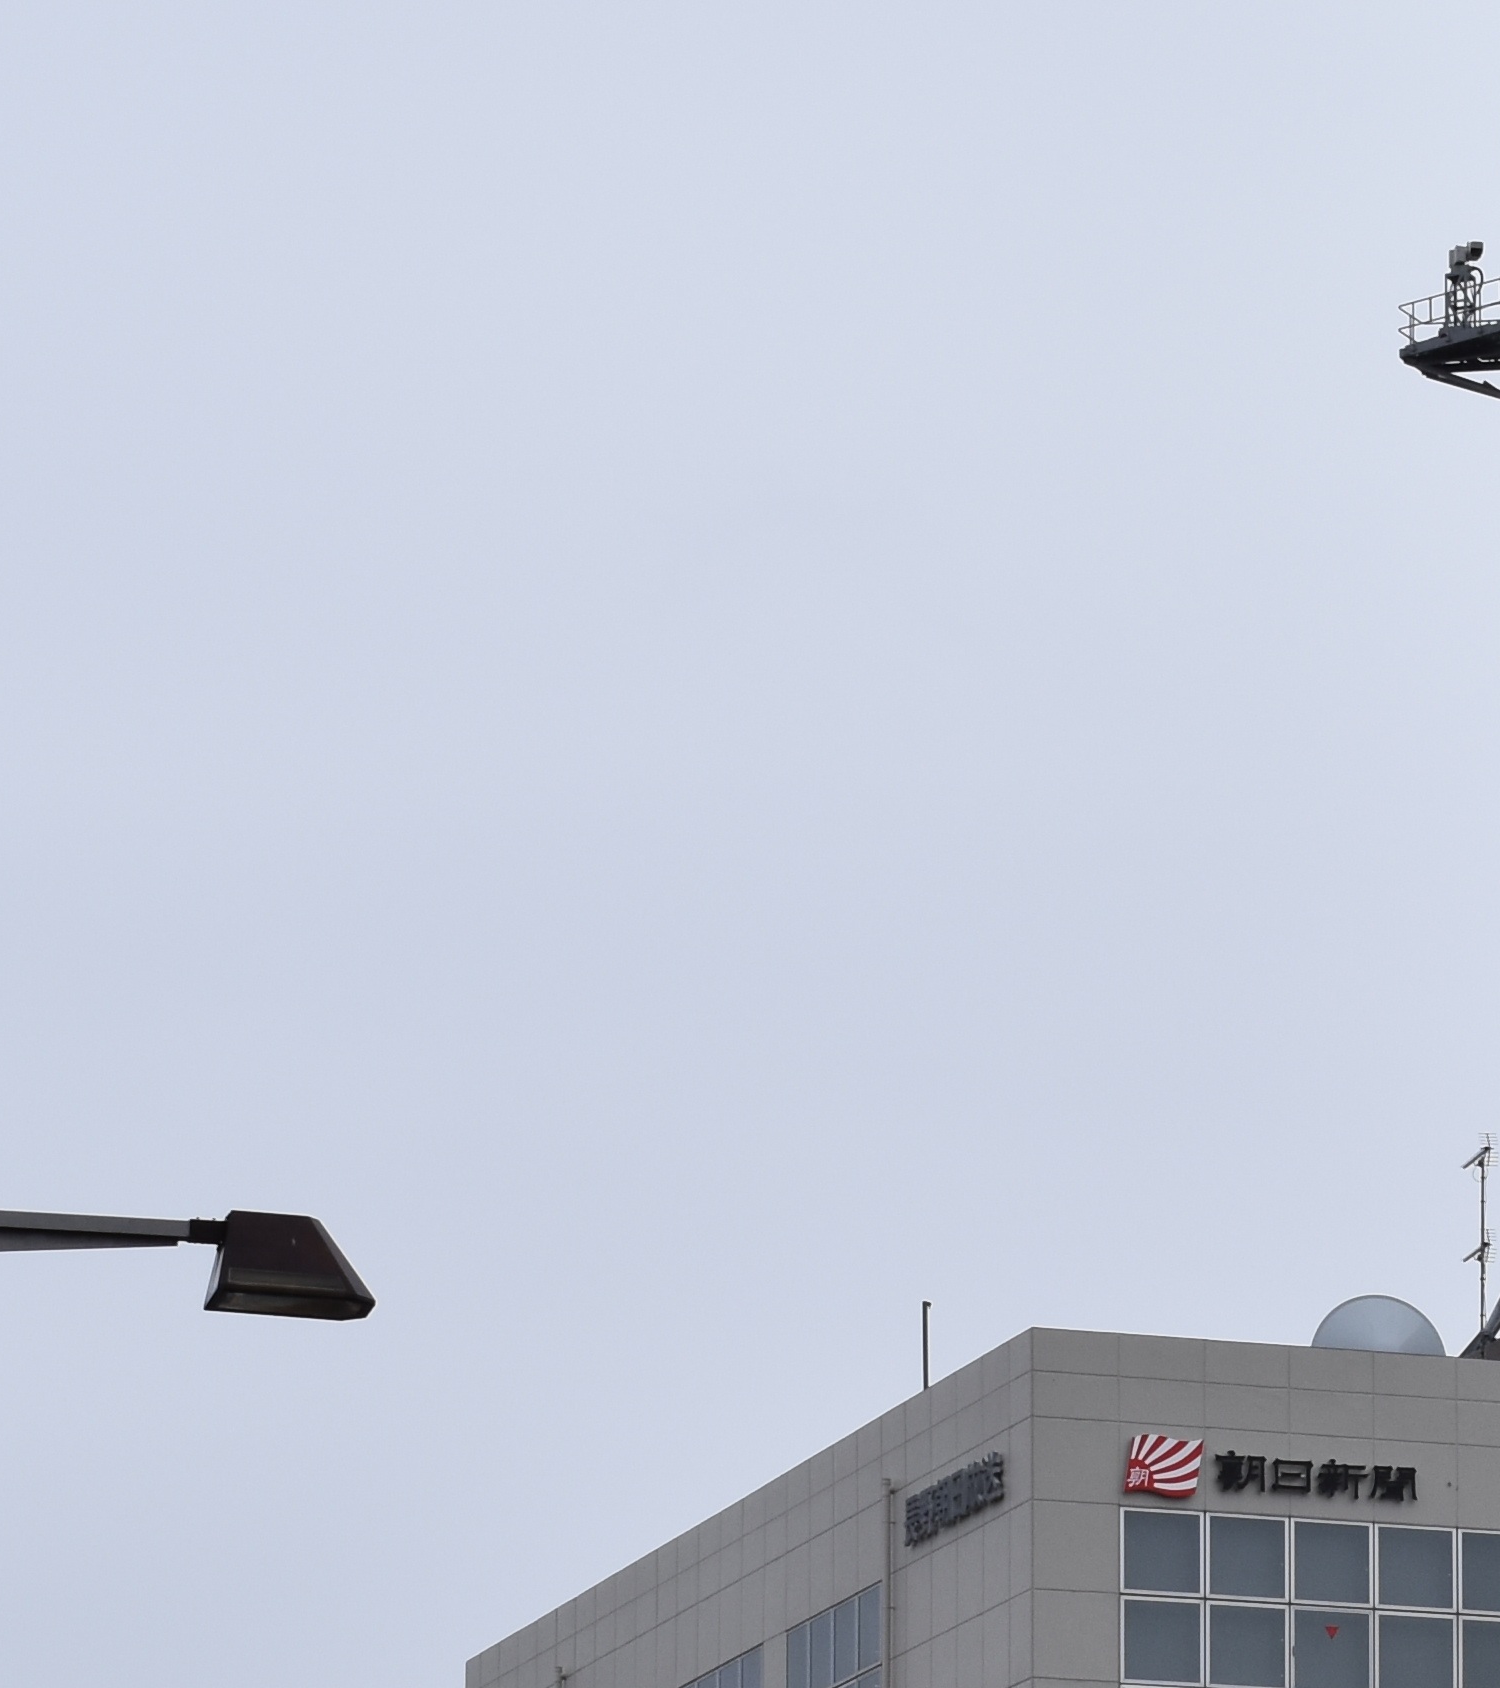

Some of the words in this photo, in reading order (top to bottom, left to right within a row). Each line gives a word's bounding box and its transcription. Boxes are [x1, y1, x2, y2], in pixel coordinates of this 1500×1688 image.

[1126, 1466, 1150, 1487] 朝
[1215, 1450, 1417, 1501] 朝日新聞
